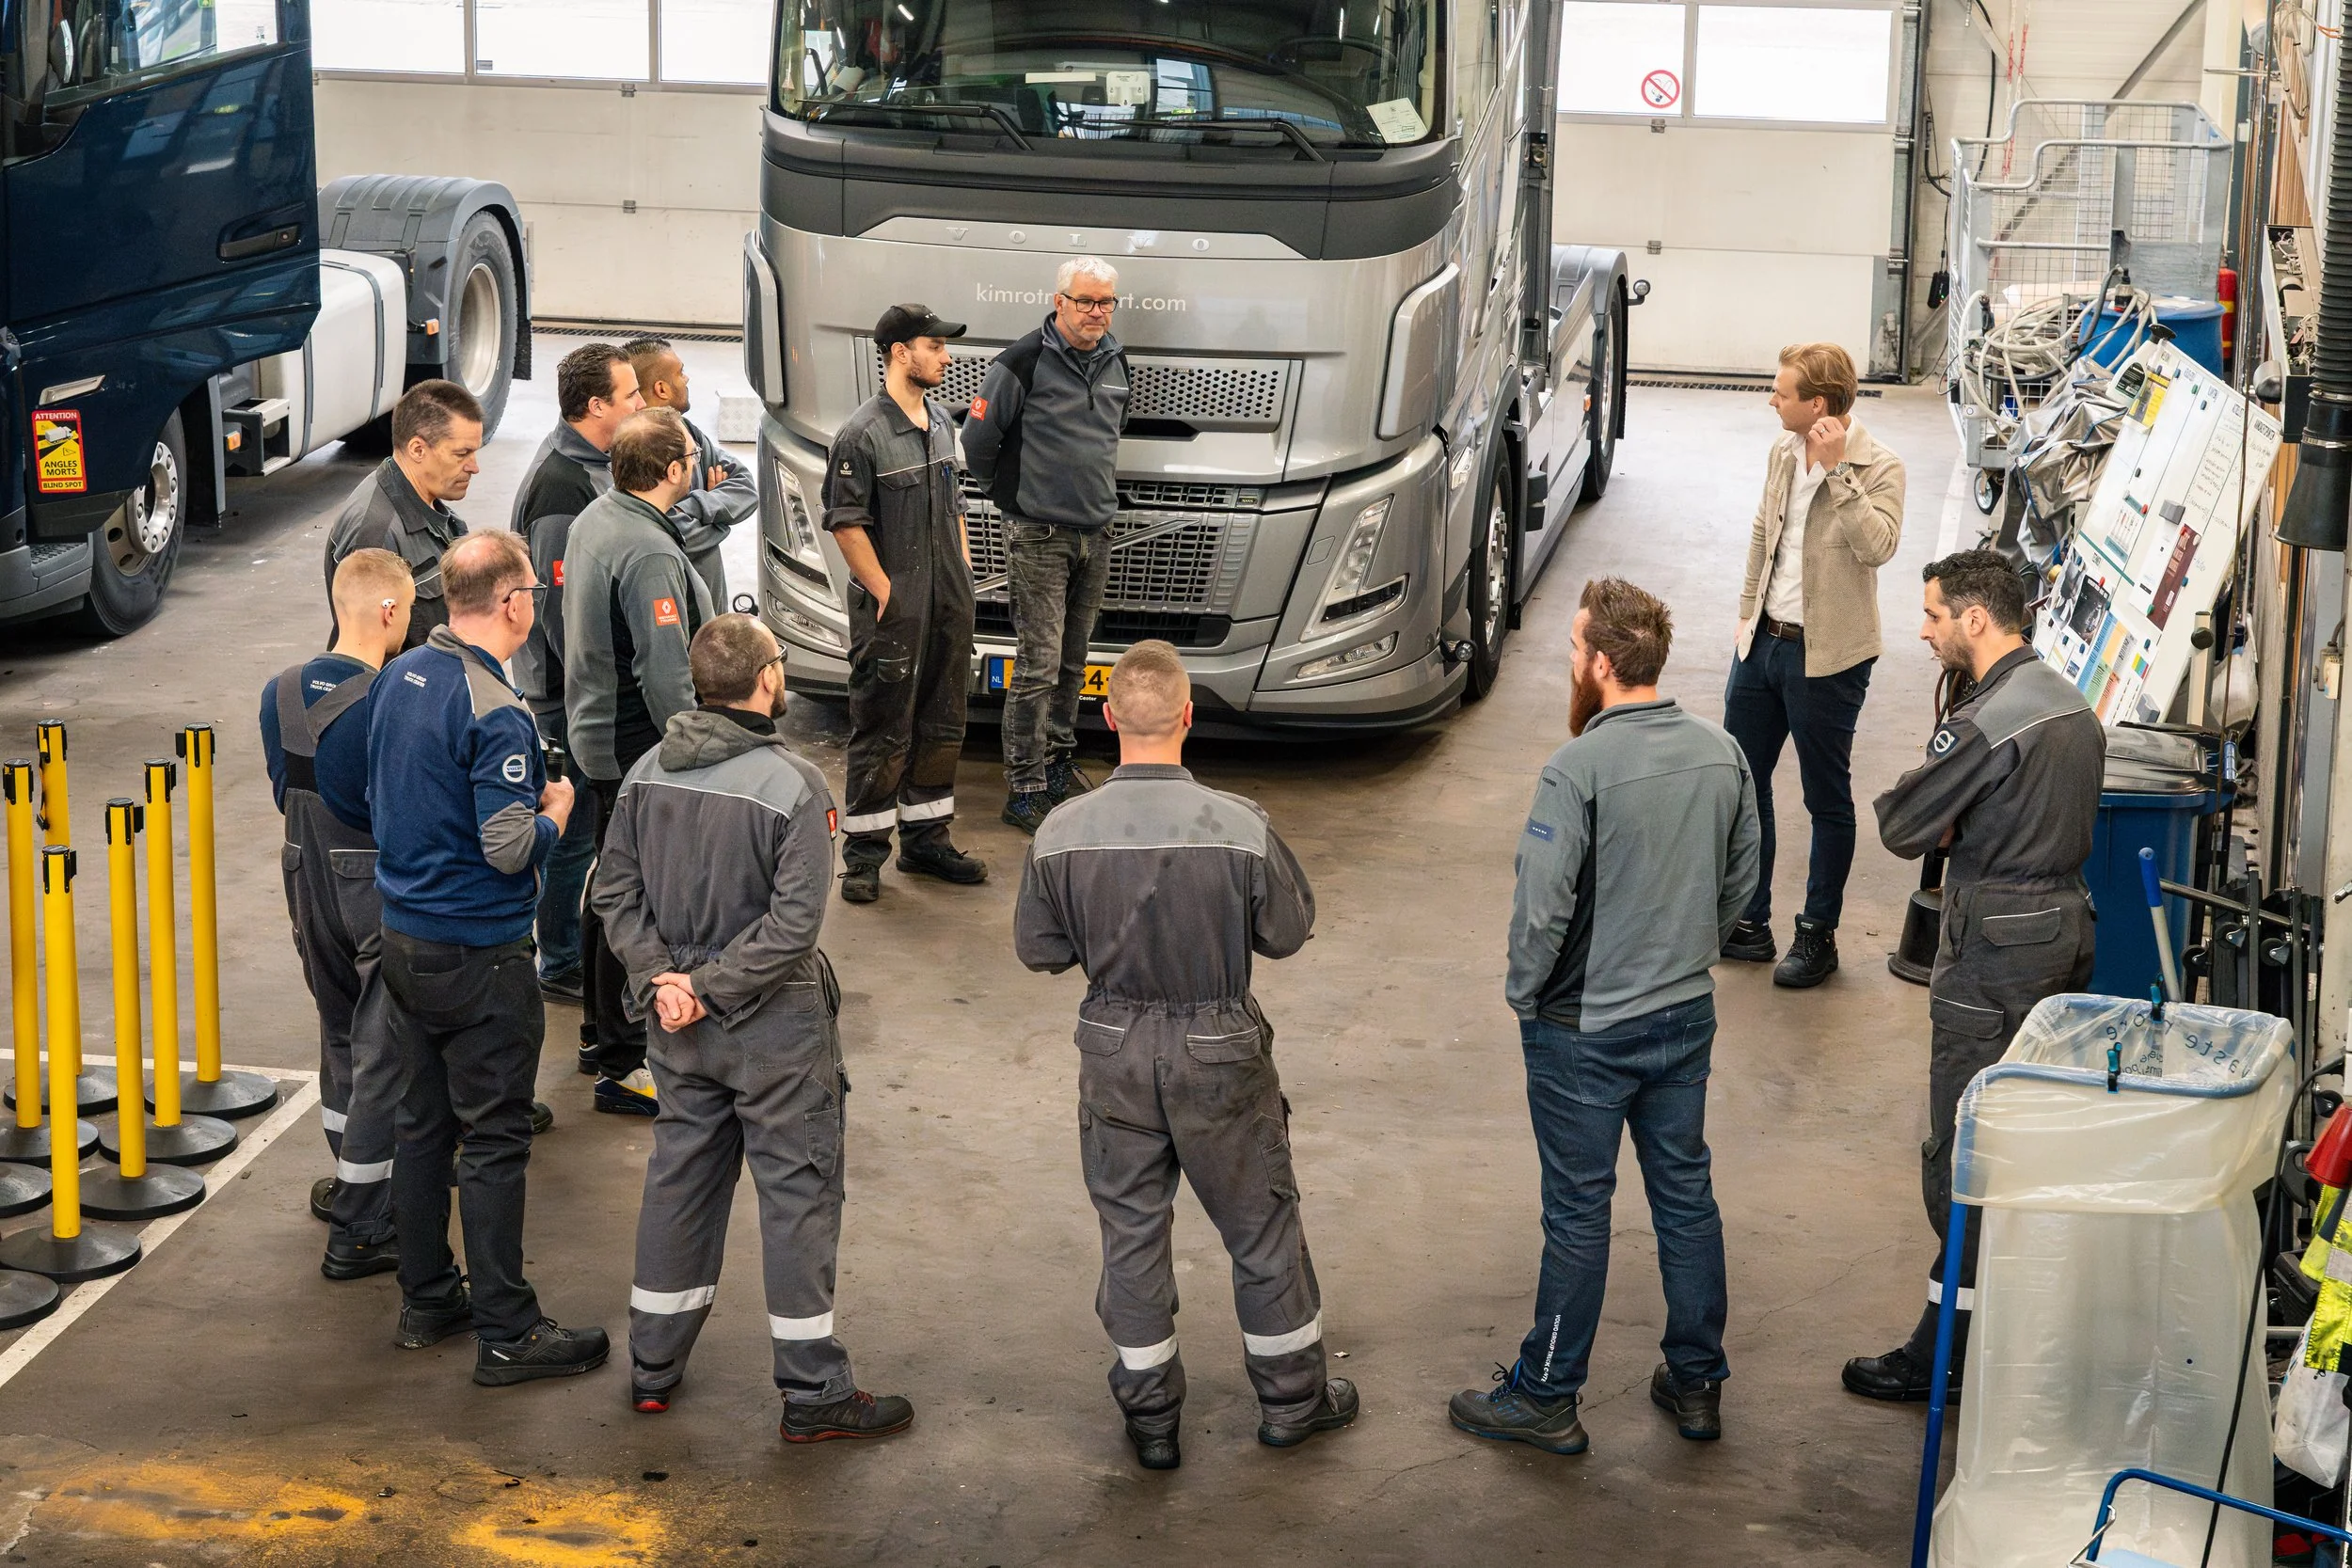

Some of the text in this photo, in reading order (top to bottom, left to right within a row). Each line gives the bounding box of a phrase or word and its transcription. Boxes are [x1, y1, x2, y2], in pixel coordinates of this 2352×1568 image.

[946, 227, 1211, 251] VOLVO
[976, 283, 1186, 311] kimrotrrt.com
[992, 675, 1002, 684] NL
[1552, 1314, 1561, 1331] VOLVO
[1549, 1331, 1557, 1350] GROUP
[1544, 1351, 1553, 1367] TRUCK
